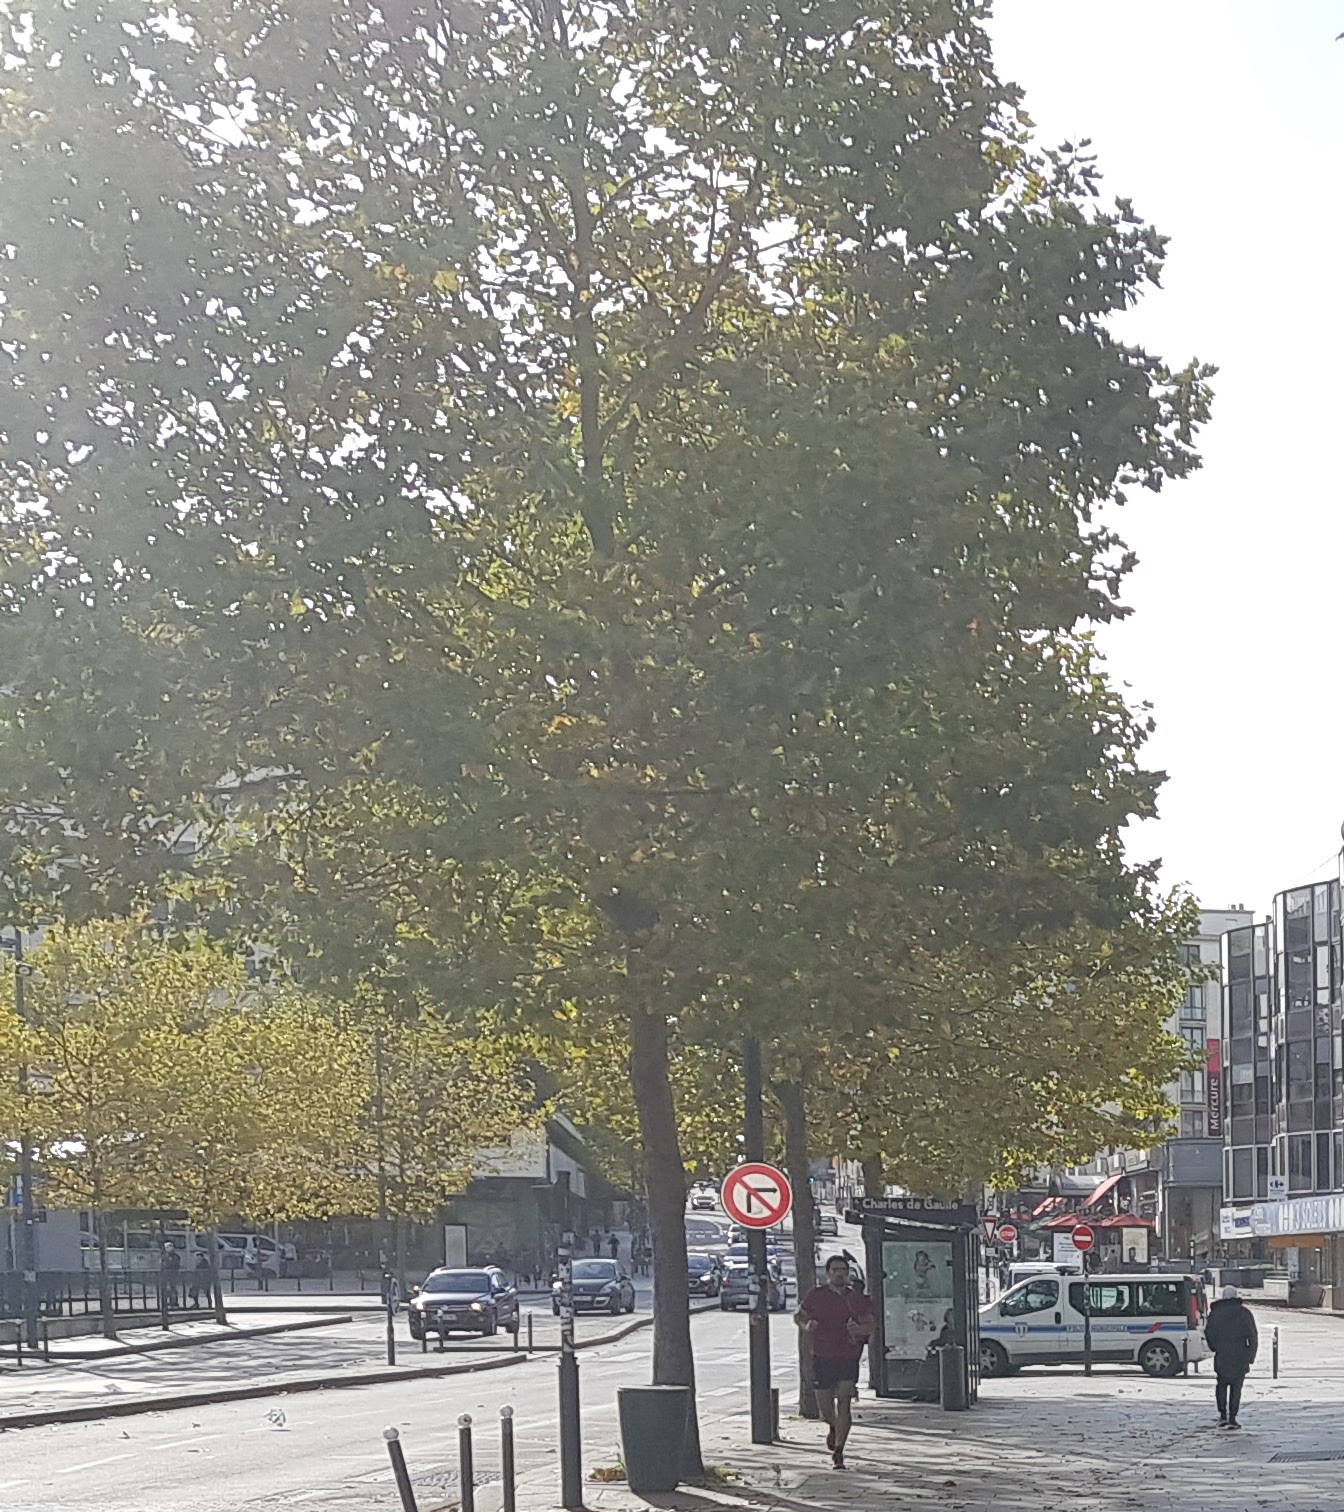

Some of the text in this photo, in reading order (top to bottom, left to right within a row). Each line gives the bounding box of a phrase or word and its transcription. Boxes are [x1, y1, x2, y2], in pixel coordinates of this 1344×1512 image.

[1210, 1078, 1219, 1130] Mercure
[862, 1198, 904, 1209] Charles
[906, 1199, 921, 1210] de
